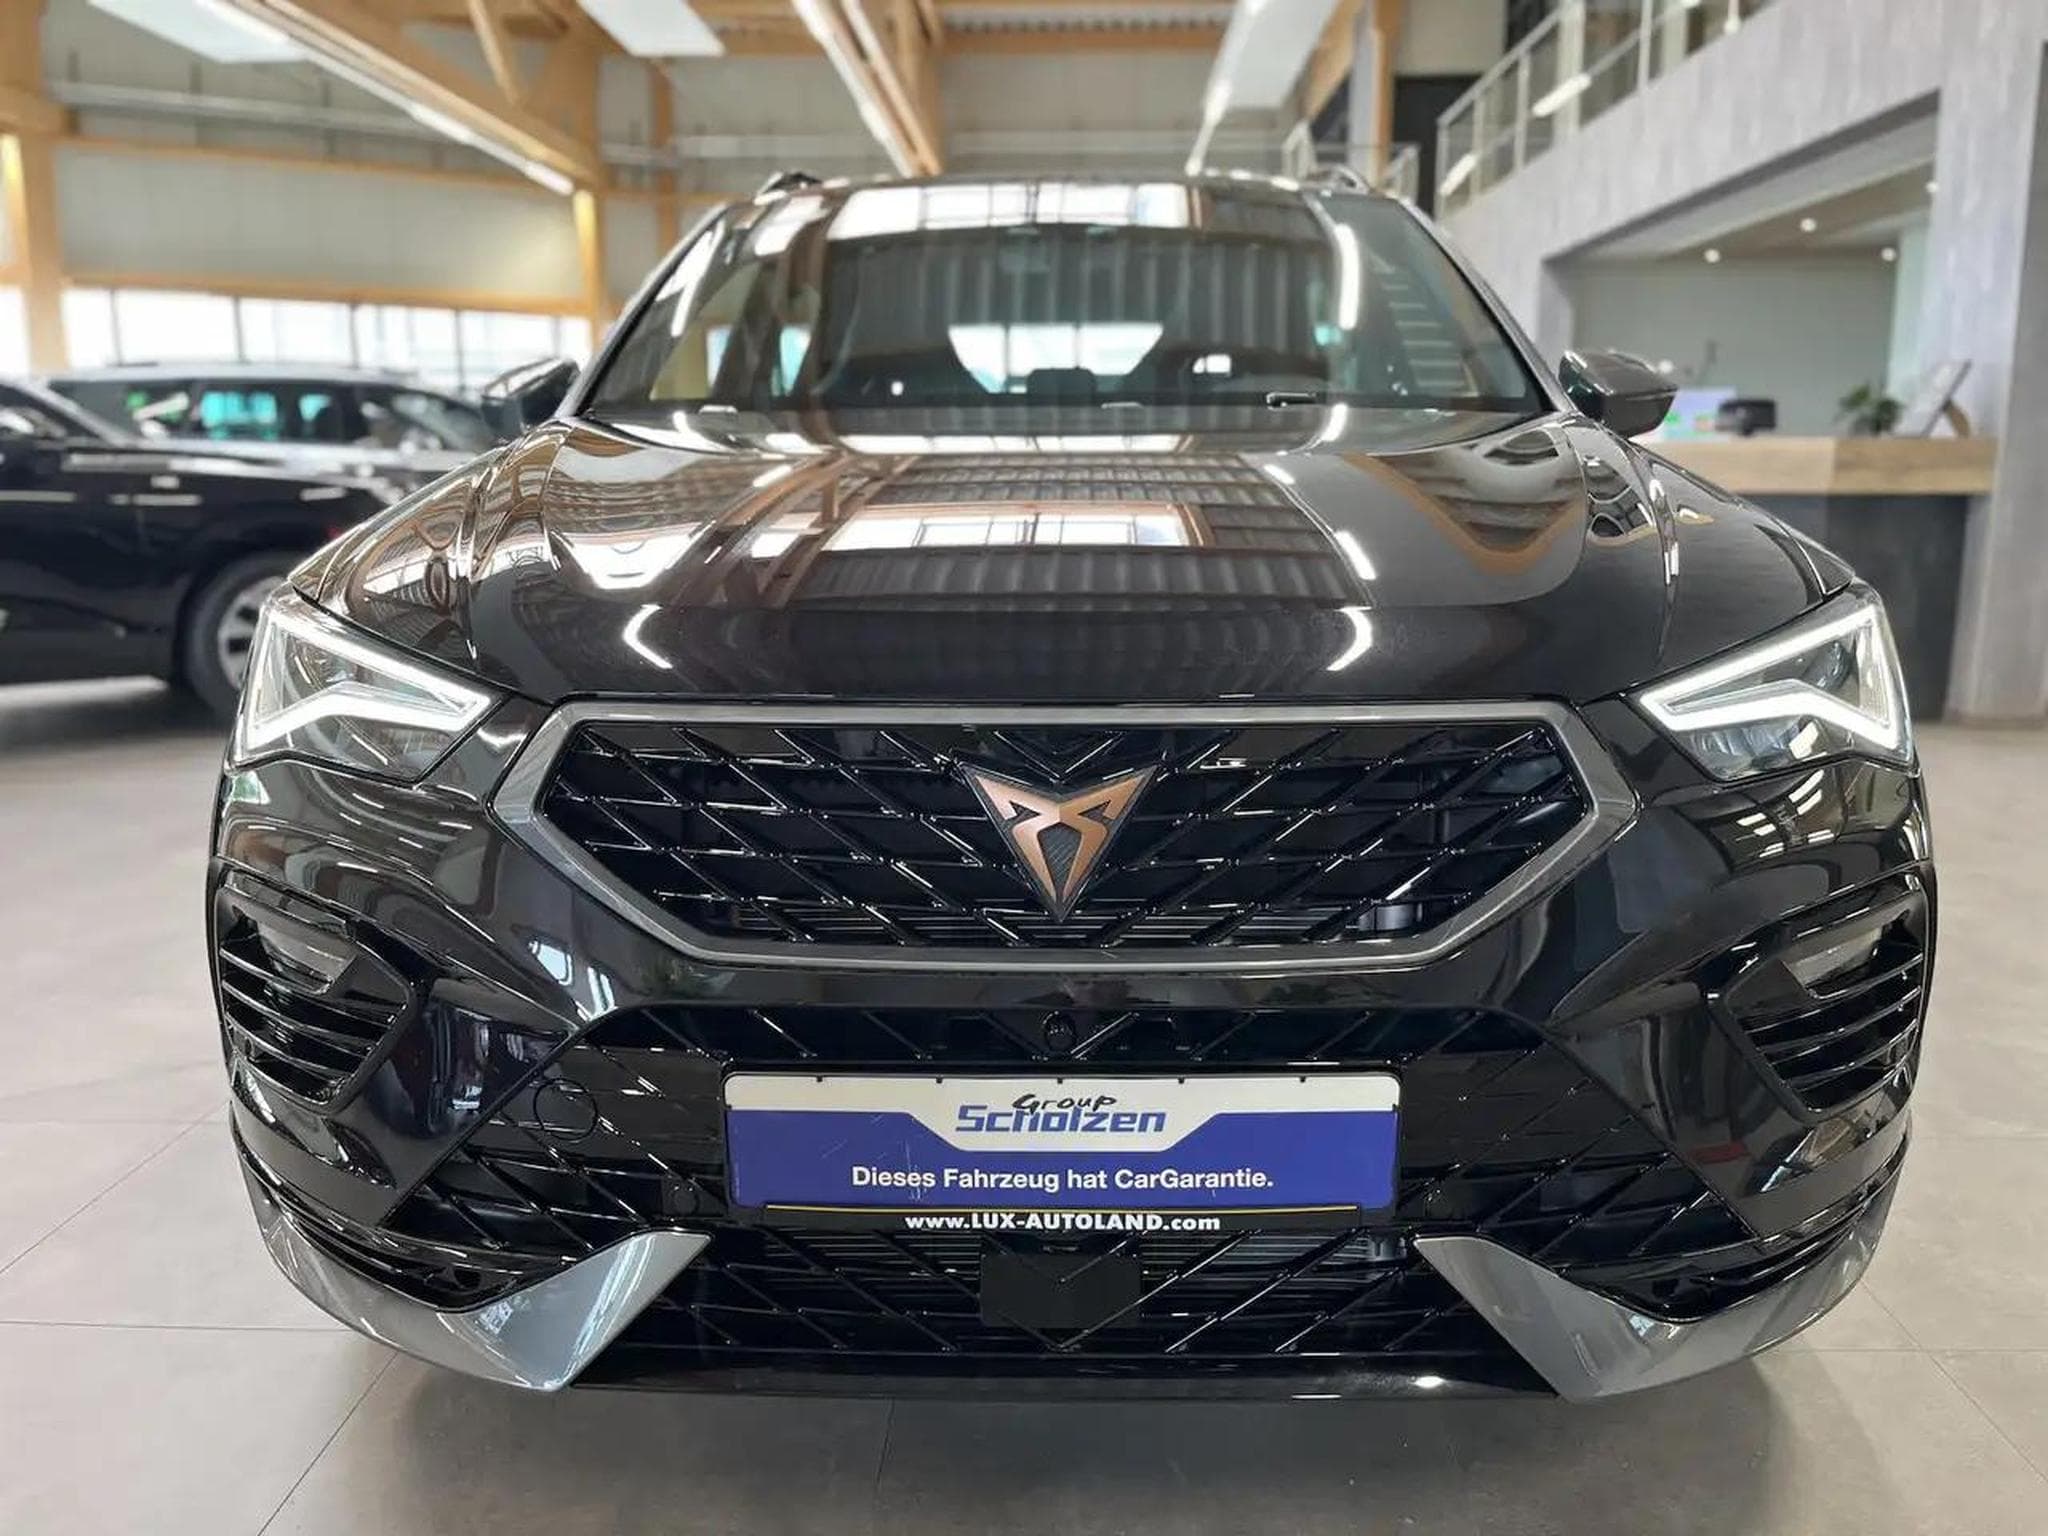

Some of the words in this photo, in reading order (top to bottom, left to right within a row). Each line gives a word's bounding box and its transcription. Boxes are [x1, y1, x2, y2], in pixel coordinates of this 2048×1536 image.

[1012, 1094, 1117, 1114] Group
[955, 1104, 1167, 1132] Scholzen
[852, 1166, 936, 1188] Dieses
[943, 1168, 1060, 1193] Fahrzeug
[1067, 1169, 1108, 1189] hat
[1114, 1168, 1274, 1189] CarGarantie.
[904, 1212, 1221, 1231] www.LUX-AUTOLAND.com
